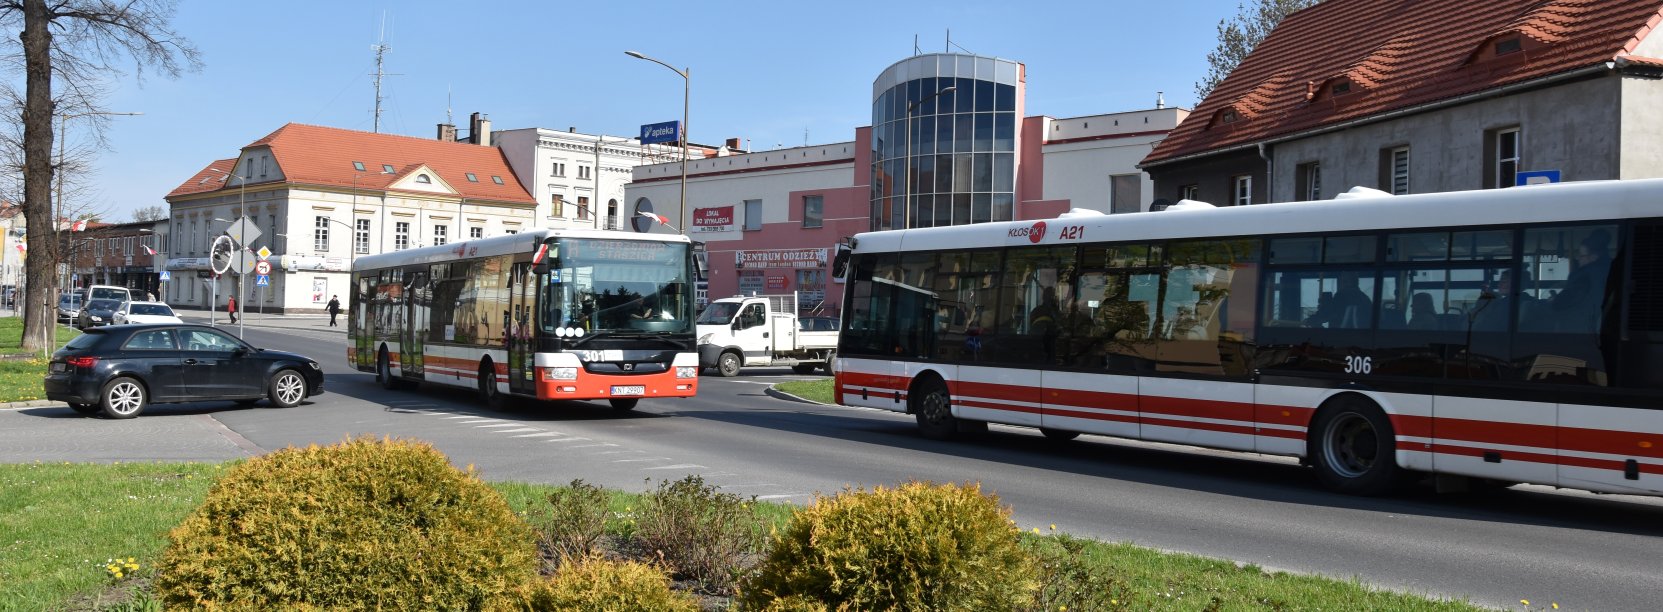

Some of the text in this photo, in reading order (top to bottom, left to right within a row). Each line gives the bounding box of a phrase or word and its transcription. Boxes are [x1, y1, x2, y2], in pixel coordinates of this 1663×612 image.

[652, 126, 674, 138] apteka
[1060, 225, 1085, 240] A21
[742, 250, 820, 261] CENTRUM ODZIEŻY
[583, 350, 605, 362] 301
[1344, 355, 1372, 375] 306
